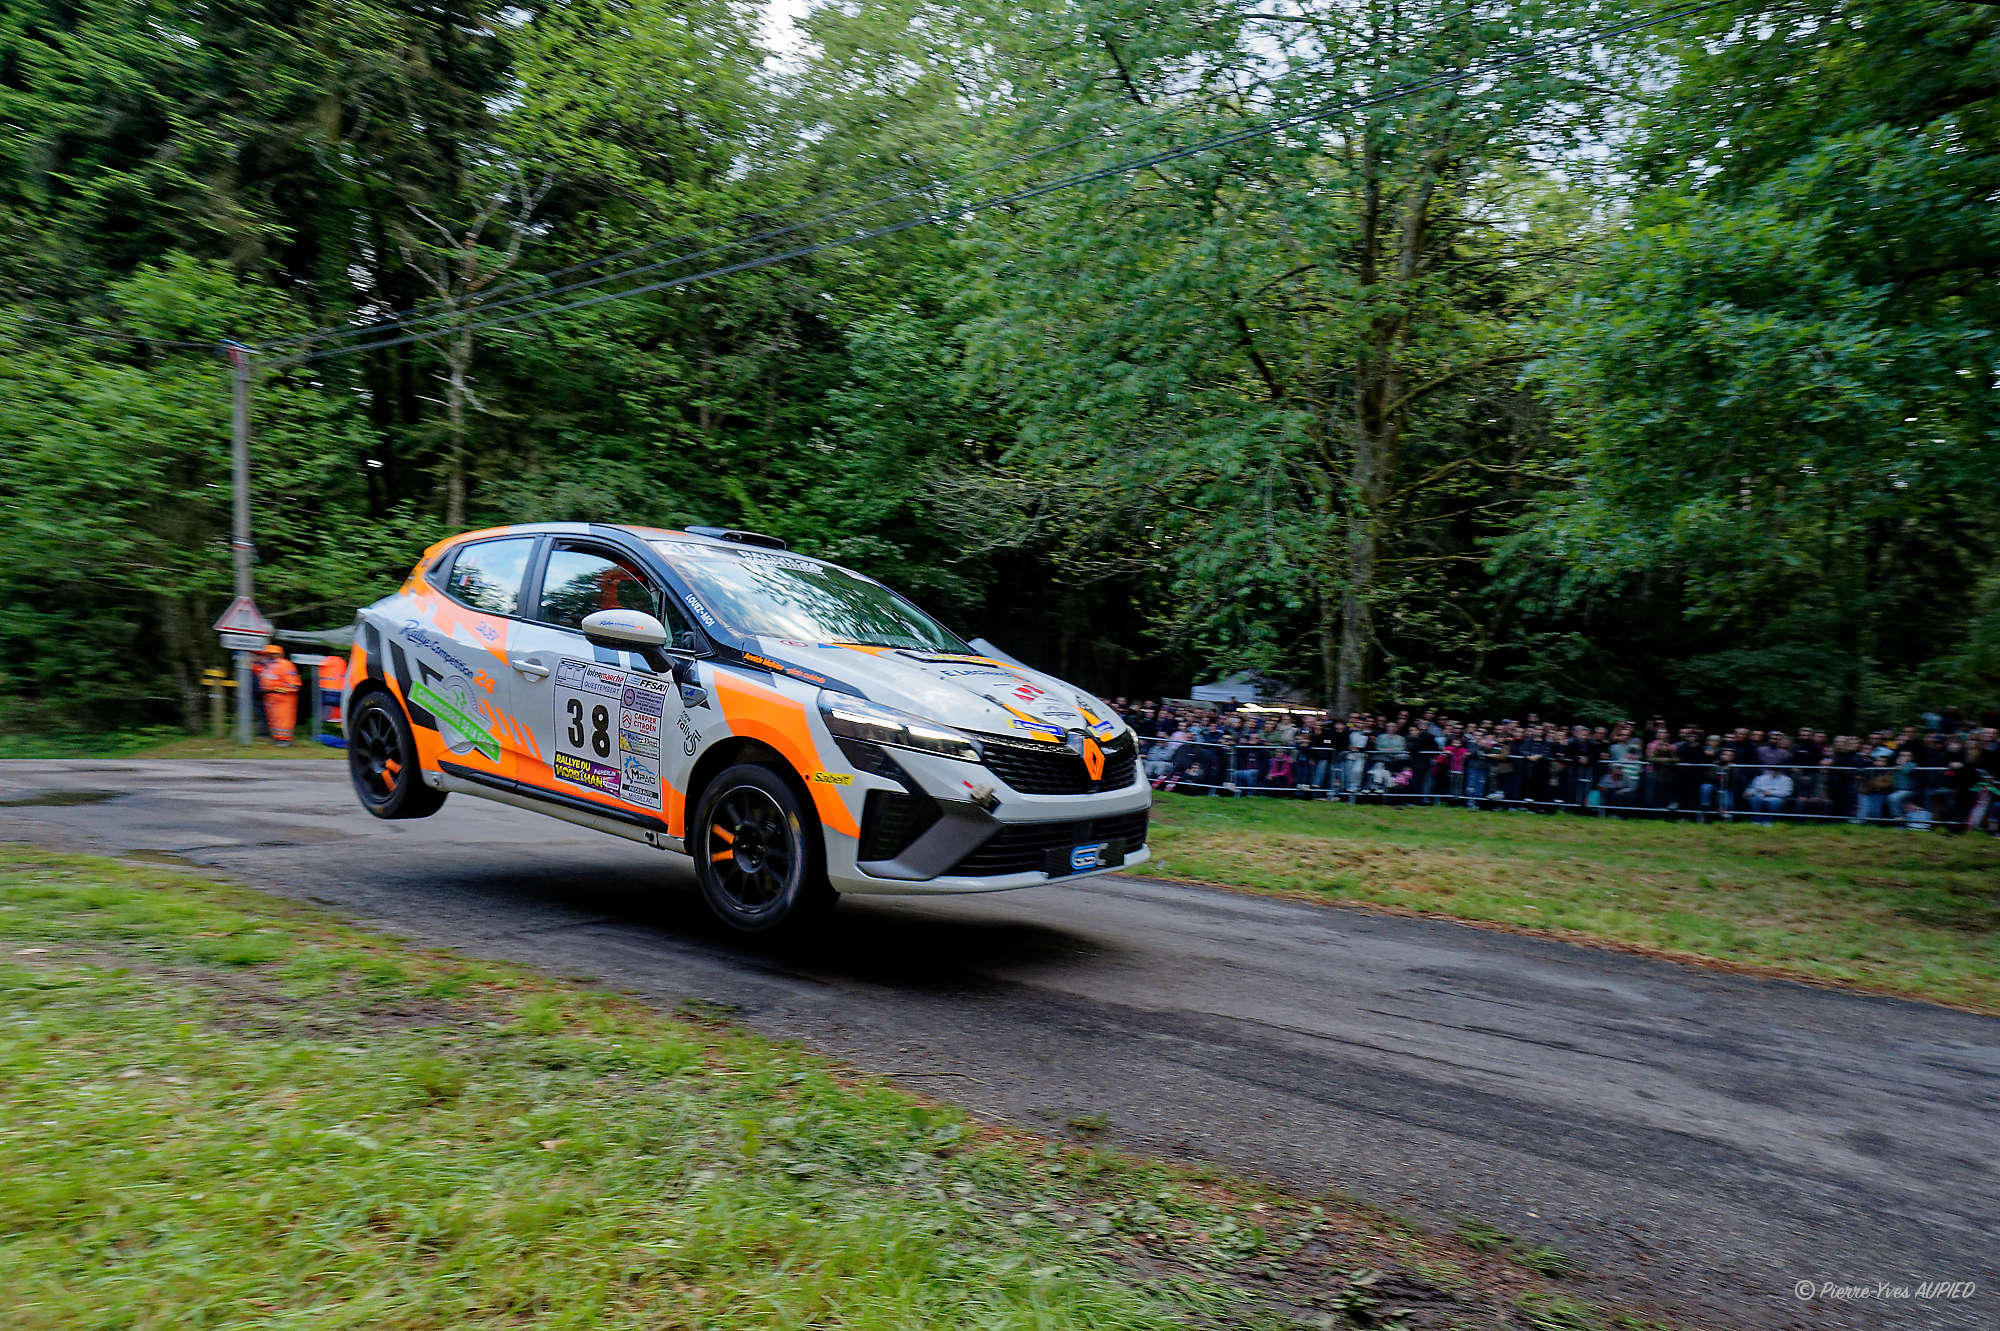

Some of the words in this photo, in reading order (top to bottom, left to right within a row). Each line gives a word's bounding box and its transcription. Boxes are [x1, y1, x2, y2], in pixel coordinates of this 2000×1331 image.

[473, 669, 496, 694] 24
[584, 681, 620, 695] QUESTEMBERT
[567, 698, 610, 758] 38
[556, 754, 580, 769] RALLYE
[580, 761, 591, 772] DU
